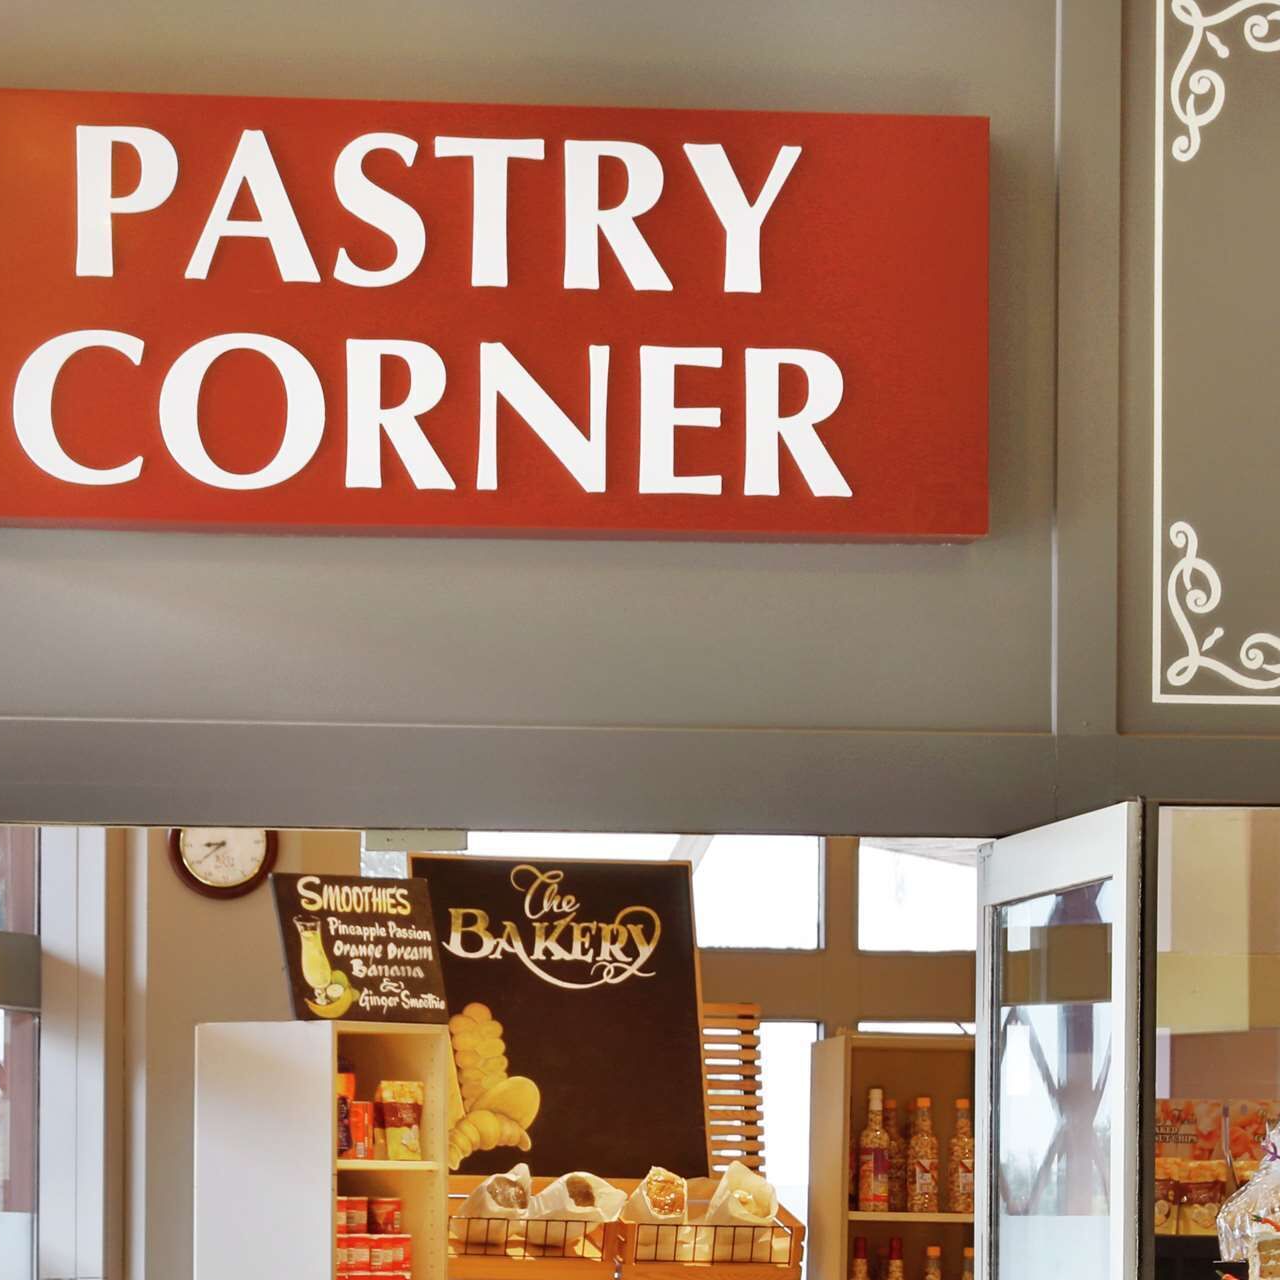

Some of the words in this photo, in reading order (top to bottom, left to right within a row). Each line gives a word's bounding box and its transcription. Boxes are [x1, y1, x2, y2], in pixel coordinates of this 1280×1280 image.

[75, 124, 802, 294] PASTRY
[12, 330, 853, 499] CORNER
[296, 876, 412, 915] SMOOTHIES
[510, 864, 581, 919] The
[327, 916, 387, 941] Pineapple
[388, 921, 432, 941] Passion
[441, 905, 662, 989] BAKERY
[333, 940, 383, 964] Orange
[388, 942, 433, 961] Dream
[350, 958, 425, 978] Banana
[359, 988, 400, 1014] Ginger
[400, 990, 446, 1010] Smoothie
